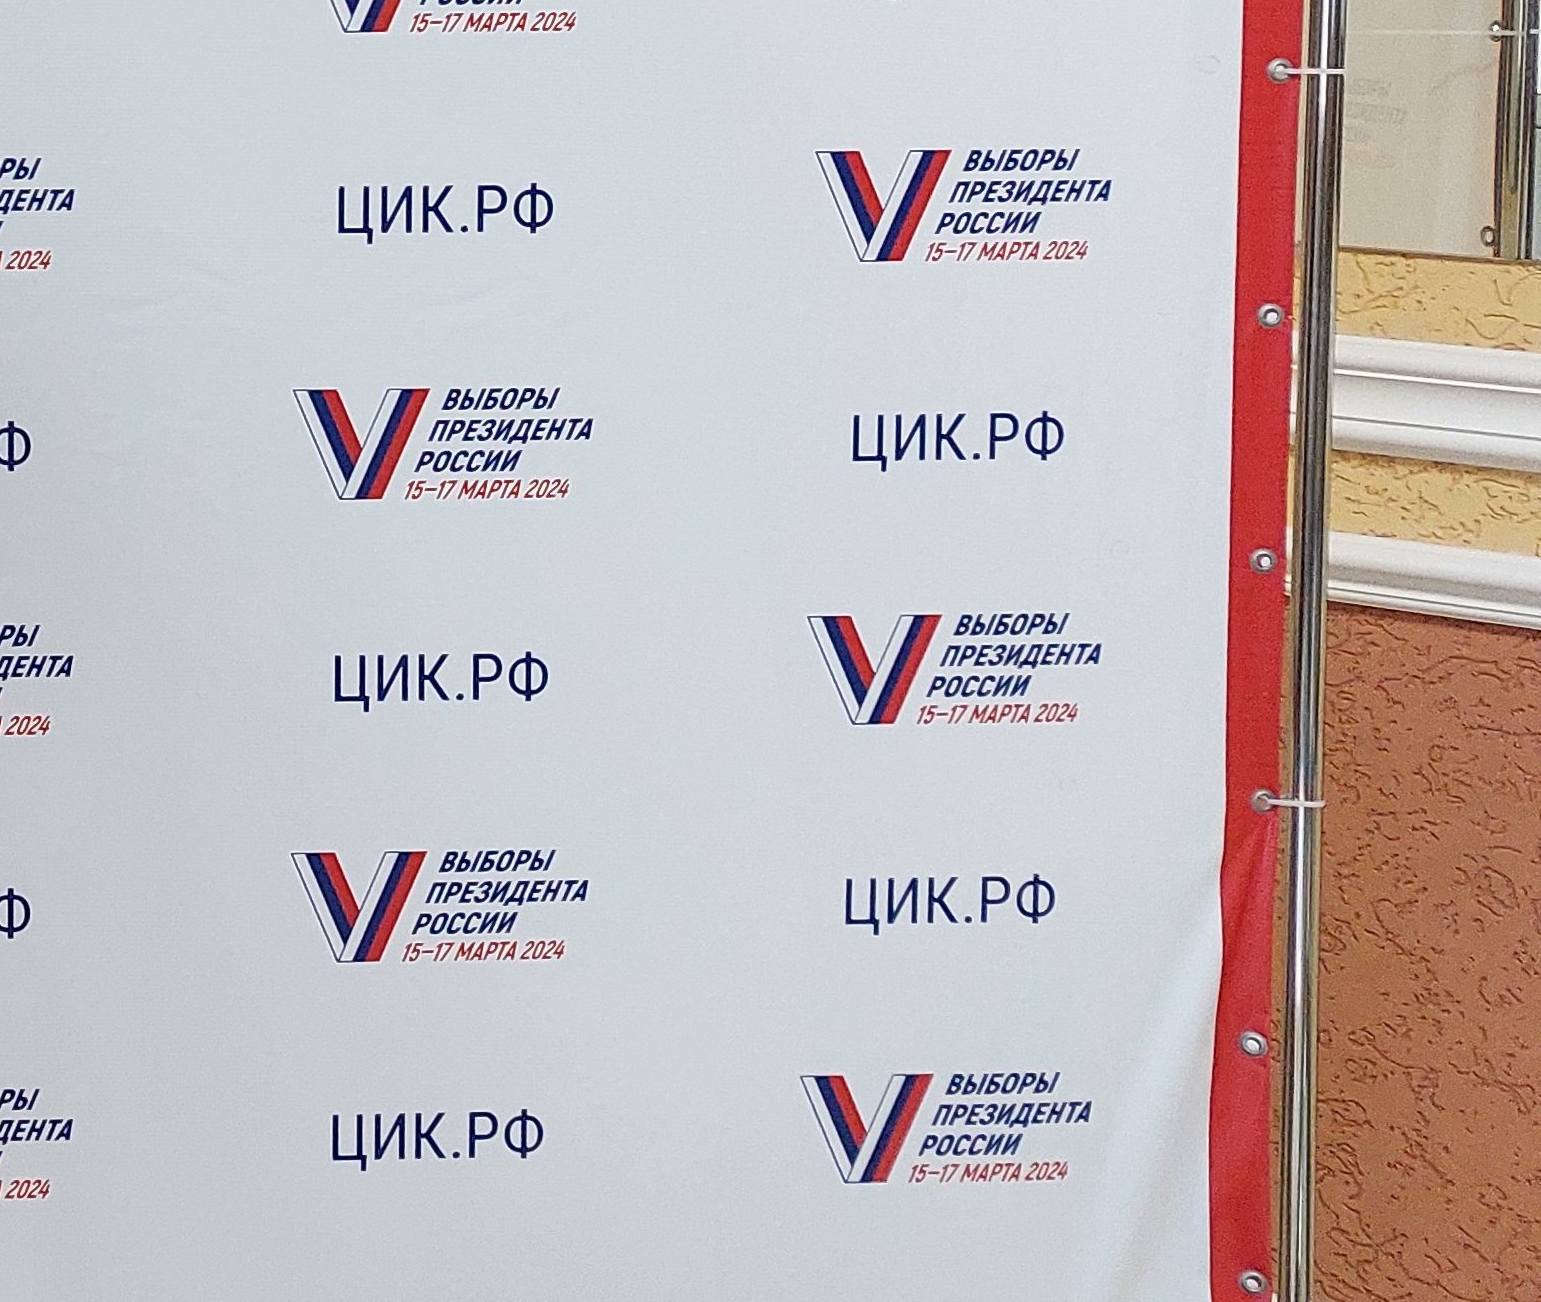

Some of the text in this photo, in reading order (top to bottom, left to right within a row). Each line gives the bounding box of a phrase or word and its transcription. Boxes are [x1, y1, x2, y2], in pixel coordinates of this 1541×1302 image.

[462, 12, 529, 33] МАРТА
[529, 11, 577, 32] 2024
[962, 148, 1081, 172] ВЫБОРЫ
[948, 179, 1112, 206] ПРЕЗИДЕНТА
[337, 182, 554, 245] ЦИК.РФ
[934, 211, 1043, 235] РОССИИ
[4, 250, 52, 270] 2024
[976, 241, 1041, 261] МАРТА
[1042, 240, 1089, 261] 2024
[441, 387, 561, 411] ВЫБОРЫ
[427, 417, 594, 445] ПРЕЗИДЕНТА
[852, 410, 1065, 473] ЦИК.РФ
[413, 449, 523, 473] РОССИИ
[457, 479, 522, 500] МАРТА
[523, 478, 570, 499] 2024
[952, 612, 1071, 637] ВЫБОРЫ
[939, 643, 1102, 670] ПРЕЗИДЕНТА
[334, 651, 549, 713] ЦИК.РФ
[925, 674, 1033, 698] РОССИИ
[967, 703, 1032, 724] МАРТА
[1033, 702, 1079, 723] 2024
[3, 715, 51, 736] 2024
[437, 849, 557, 873] ВЫБОРЫ
[424, 879, 589, 907] ПРЕЗИДЕНТА
[845, 873, 1056, 936] ЦИК.РФ
[411, 911, 519, 936] РОССИИ
[453, 940, 518, 962] МАРТА
[519, 940, 565, 960] 2024
[944, 1071, 1061, 1096] ВЫБОРЫ
[931, 1100, 1093, 1129] ПРЕЗИДЕНТА
[331, 1108, 544, 1172] ЦИК.РФ
[917, 1133, 1024, 1157] РОССИИ
[959, 1162, 1023, 1183] МАРТА
[1024, 1161, 1068, 1181] 2024
[4, 1179, 51, 1200] 2024
